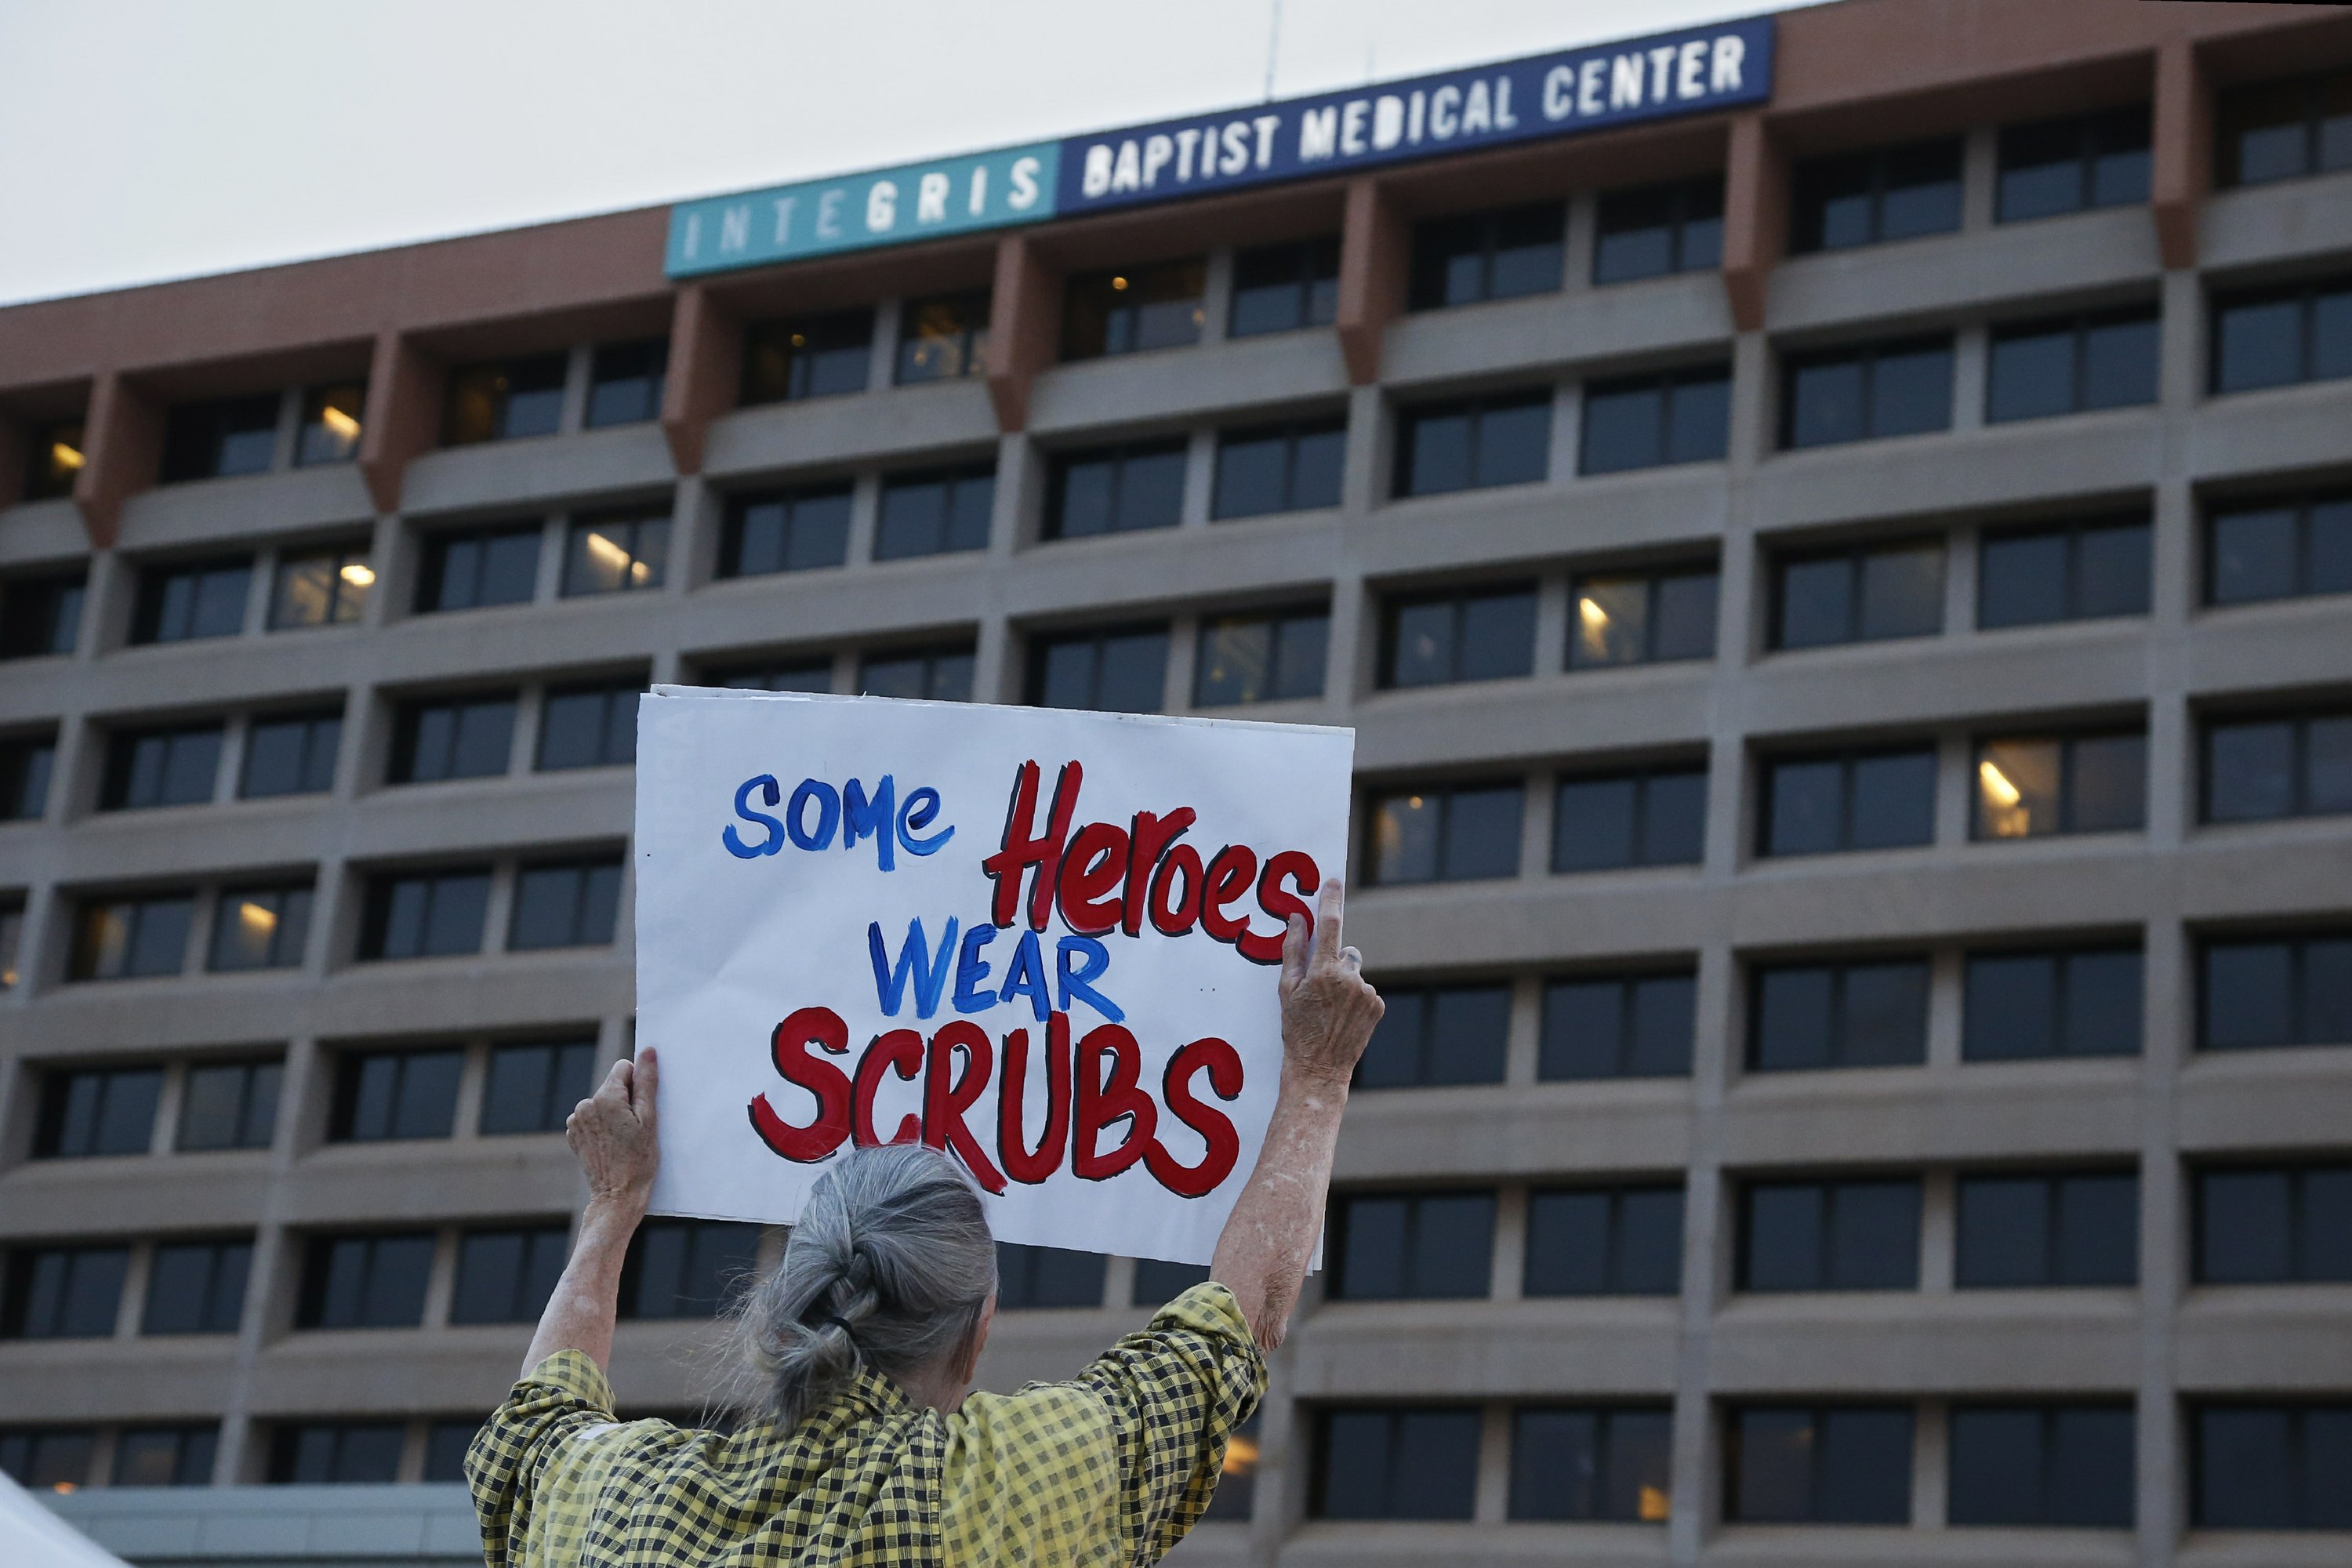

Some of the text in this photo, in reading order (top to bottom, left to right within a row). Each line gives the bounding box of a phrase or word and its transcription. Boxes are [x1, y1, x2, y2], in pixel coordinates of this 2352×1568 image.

[683, 34, 1747, 259] INTEGRIS BAPTIST MEDICAL CENTER
[983, 759, 1320, 965] Heroes
[867, 916, 1125, 1022] WEAR
[748, 1007, 1244, 1198] SCRUBS
